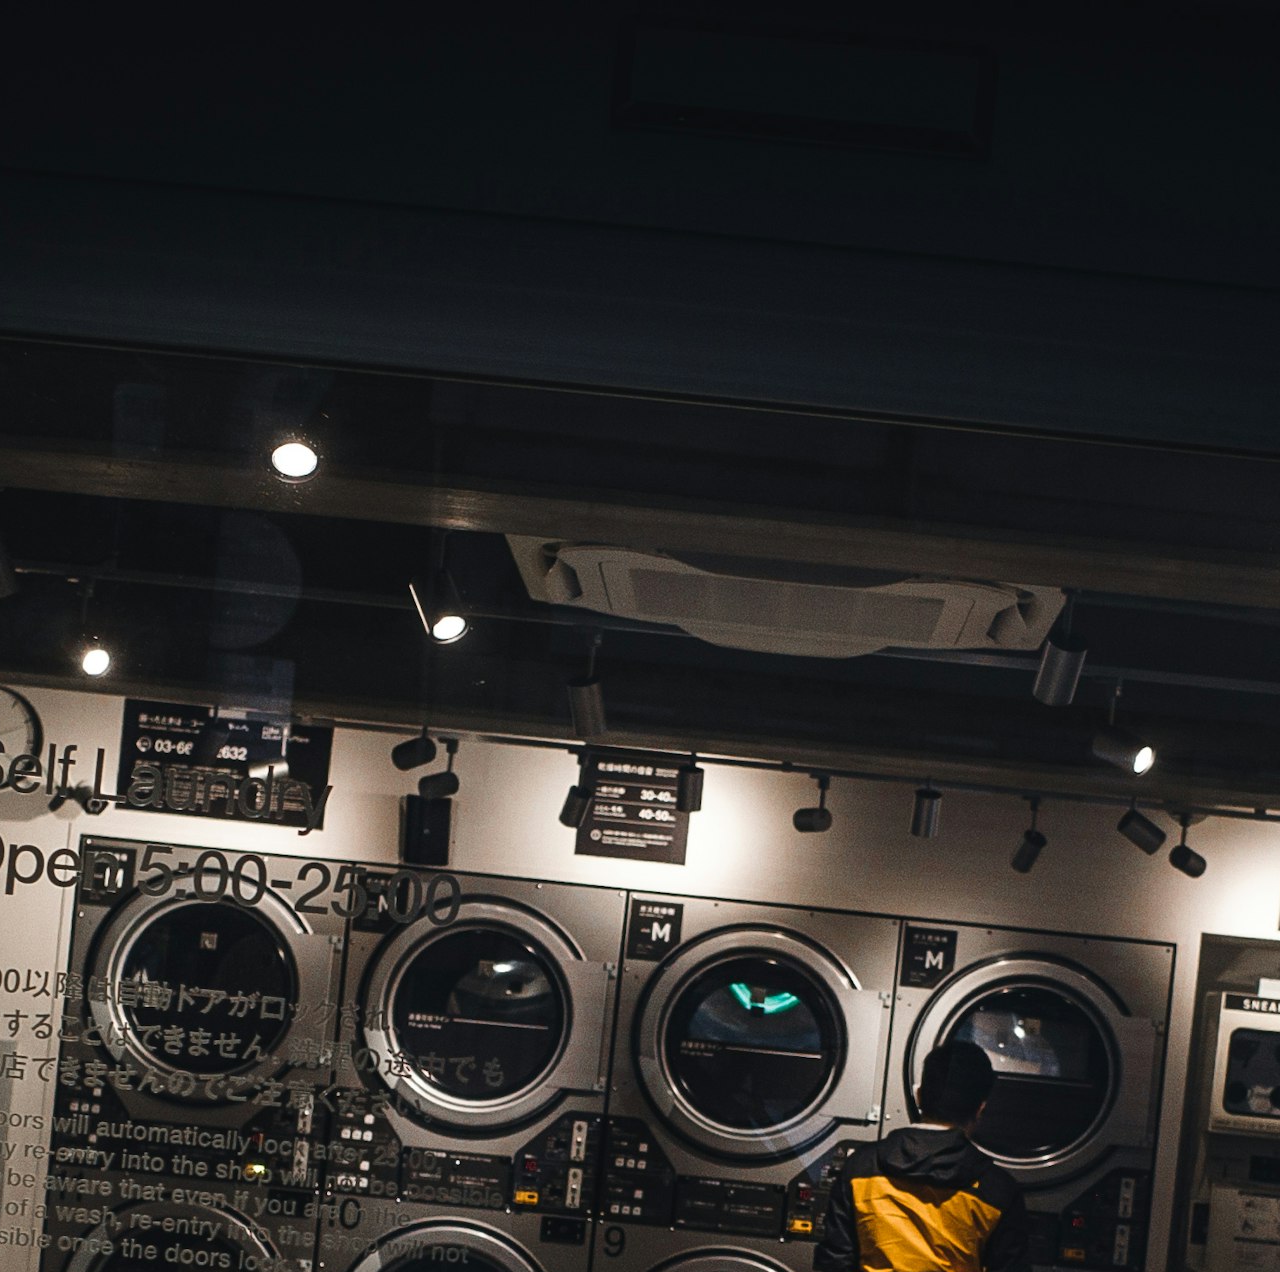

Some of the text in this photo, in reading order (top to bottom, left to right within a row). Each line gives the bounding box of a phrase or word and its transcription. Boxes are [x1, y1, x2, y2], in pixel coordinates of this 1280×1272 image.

[93, 747, 335, 836] Laundry
[137, 844, 462, 927] 5:00-25:00
[651, 921, 671, 943] M
[924, 949, 944, 970] M
[53, 1114, 90, 1136] will
[96, 1119, 252, 1156] automatically
[315, 1140, 368, 1162] after
[24, 1143, 115, 1172] re-entry
[121, 1149, 165, 1173] into
[171, 1154, 209, 1177] the
[215, 1160, 272, 1185] shop
[281, 1165, 318, 1188] will
[370, 1175, 400, 1198] be
[7, 1168, 35, 1188] be
[44, 1174, 112, 1197] aware
[118, 1178, 166, 1202] that
[171, 1186, 227, 1208] even
[232, 1189, 251, 1209] if
[254, 1193, 297, 1217] you
[373, 1206, 412, 1227] the
[5, 1199, 30, 1218] of
[35, 1204, 48, 1219] a
[56, 1205, 122, 1231] wash,
[130, 1211, 220, 1241] re-entry
[278, 1224, 315, 1247] the
[387, 1238, 423, 1260] will
[430, 1243, 470, 1265] not
[57, 1234, 114, 1256] once
[121, 1239, 158, 1261] the
[165, 1243, 231, 1269] doors
[604, 1226, 626, 1257] 9
